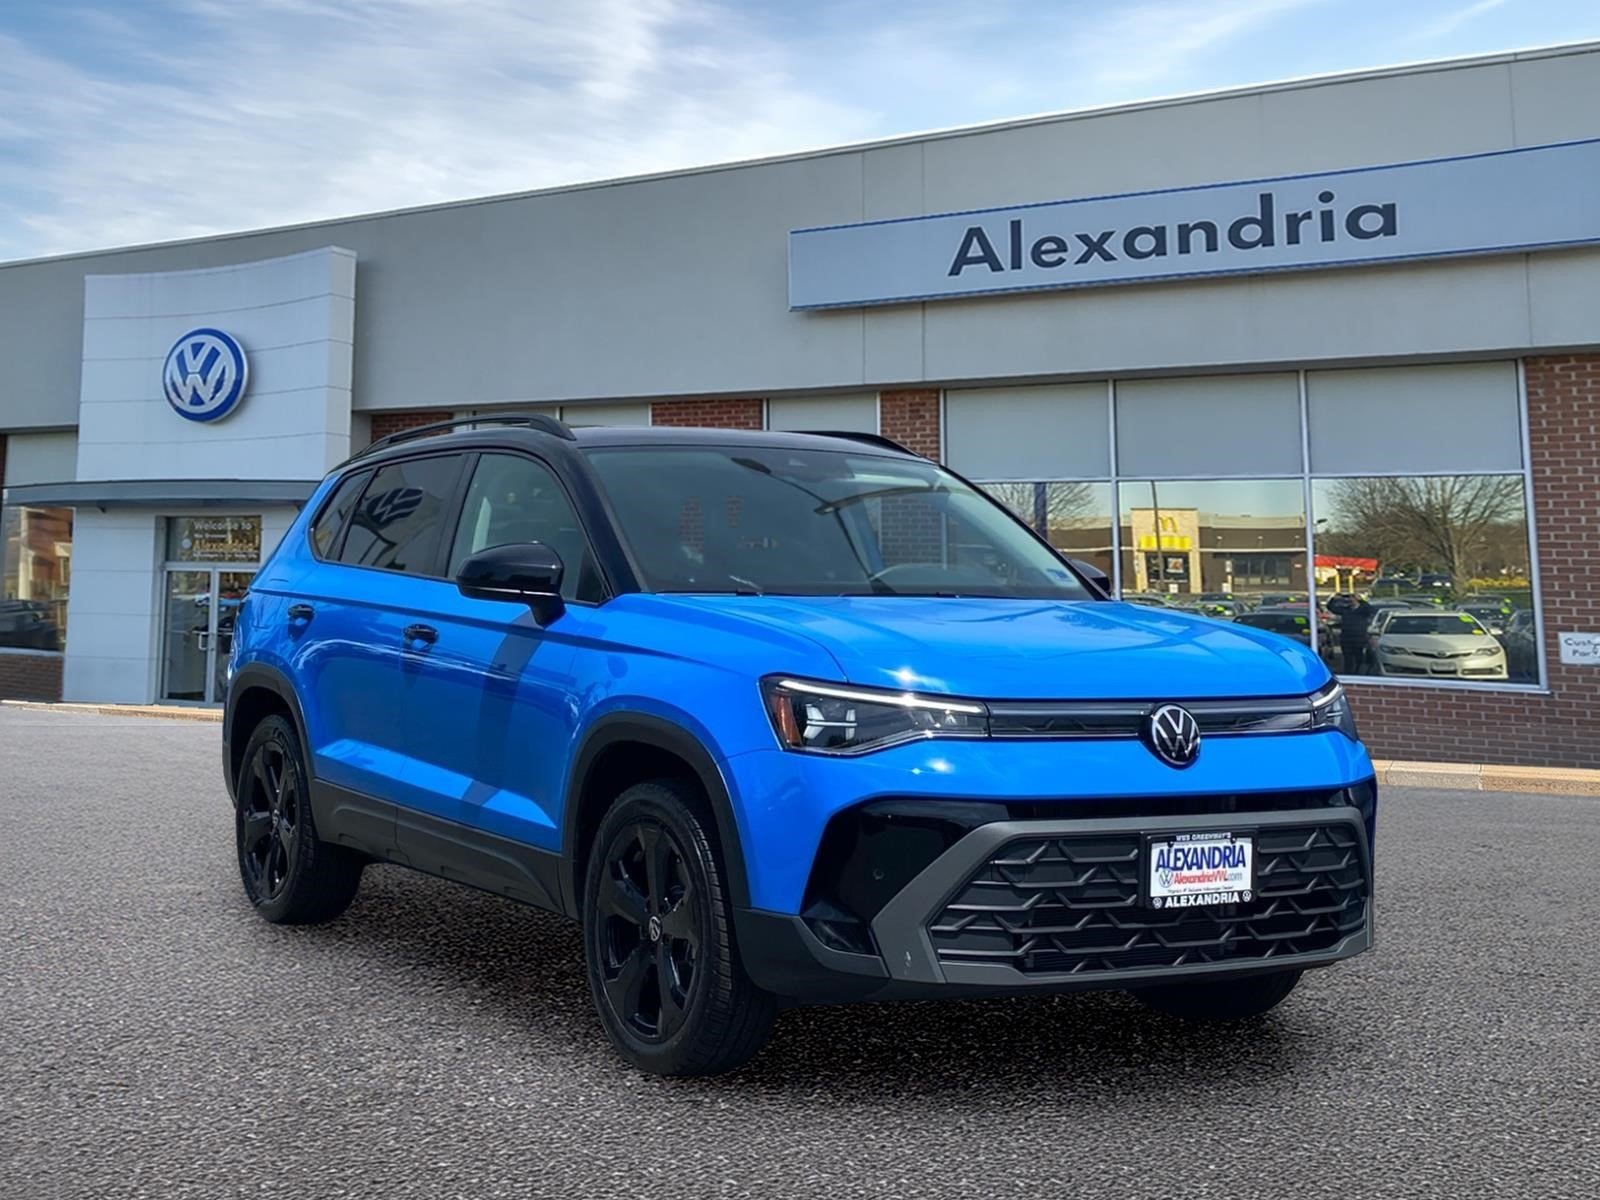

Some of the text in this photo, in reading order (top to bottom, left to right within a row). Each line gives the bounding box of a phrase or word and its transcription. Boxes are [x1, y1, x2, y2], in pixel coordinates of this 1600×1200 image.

[948, 191, 1398, 276] Alexandria
[163, 329, 245, 421] VW
[1152, 705, 1200, 765] VW
[1155, 845, 1246, 872] ALEXANDRIA
[1164, 891, 1240, 908] ALEXANDRIA
